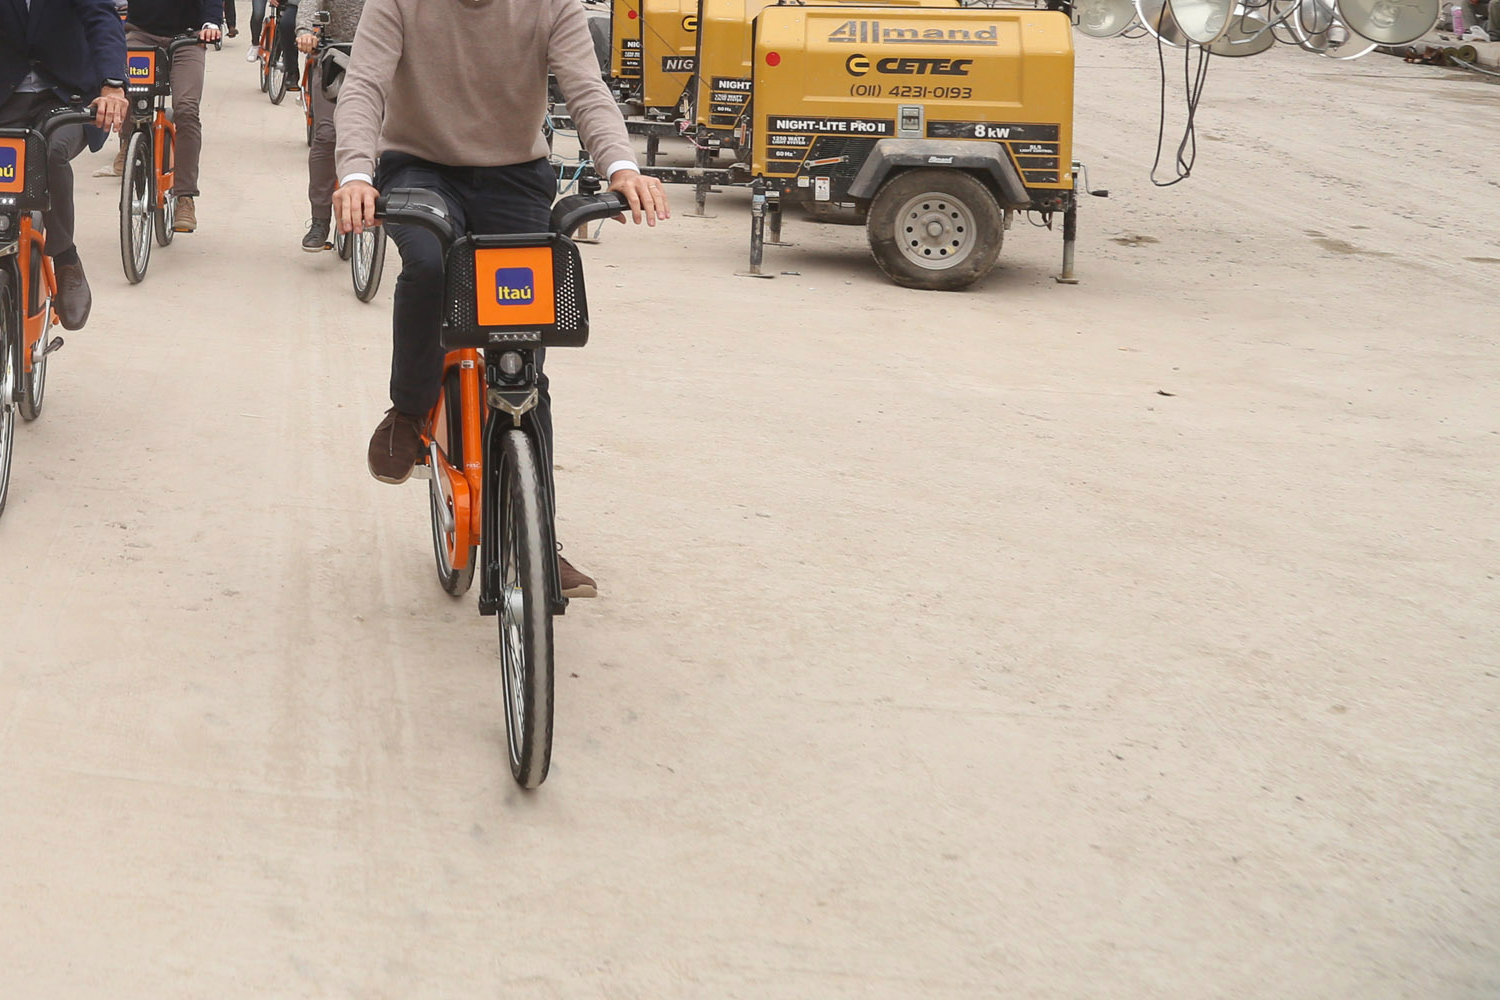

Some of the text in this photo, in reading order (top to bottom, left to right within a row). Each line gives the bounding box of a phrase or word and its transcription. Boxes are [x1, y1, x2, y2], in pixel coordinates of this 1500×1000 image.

[828, 20, 997, 44] Allmand
[129, 66, 149, 75] Itaú
[876, 57, 973, 76] CETEC
[850, 84, 972, 99] (011) 4231-0193
[776, 120, 886, 132] NIGHT-LITE PRO II
[974, 124, 1010, 138] 8 kW
[498, 285, 532, 300] Itaú
